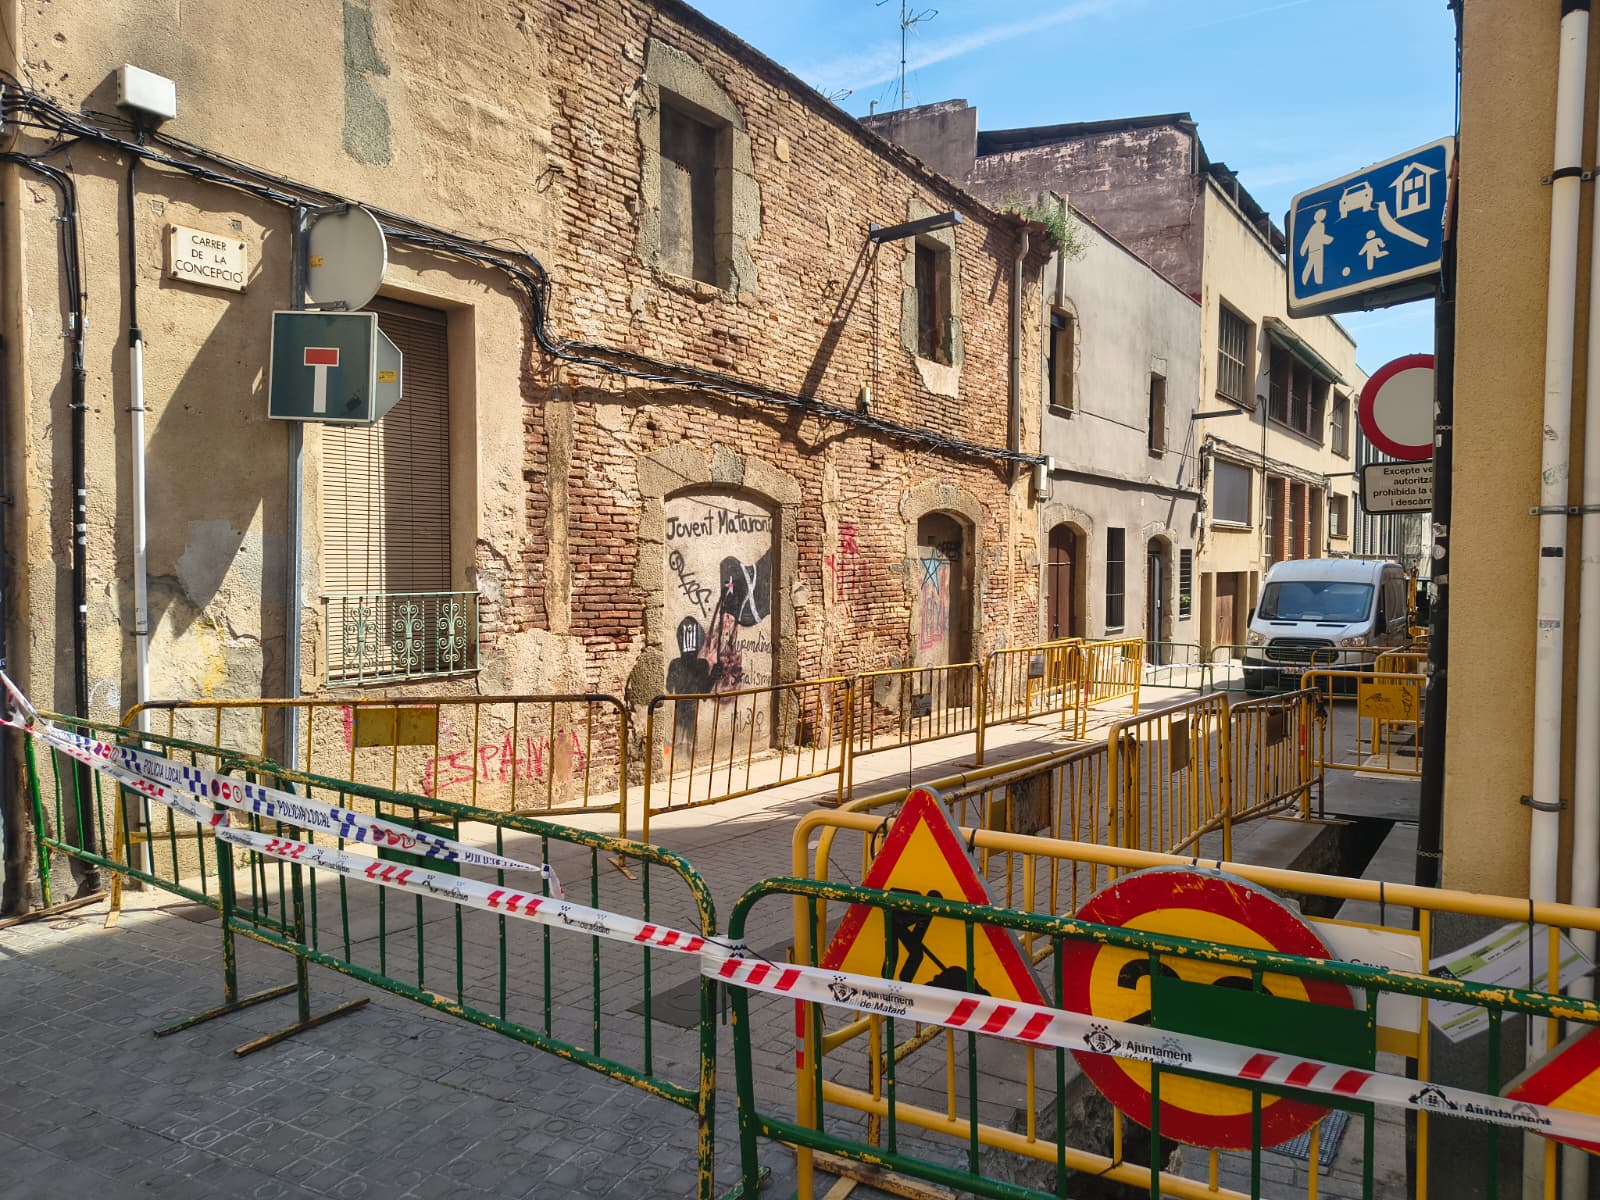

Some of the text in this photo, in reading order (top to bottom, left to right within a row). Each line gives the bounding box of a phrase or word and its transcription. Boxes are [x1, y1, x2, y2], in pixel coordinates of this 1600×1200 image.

[191, 235, 227, 251] CARRER
[191, 248, 227, 265] DE LA
[175, 259, 244, 284] CONCEPCIÓ
[1383, 466, 1420, 476] Excepte
[1373, 487, 1416, 499] prohibida
[1418, 487, 1427, 495] la
[666, 509, 714, 540] Jovent
[143, 758, 164, 779] POLICIA
[164, 765, 183, 785] LOCAL
[276, 799, 331, 829] POLICIA LOCAL
[859, 998, 907, 1017] de Mataró
[861, 988, 914, 1008] Ajuntament
[1126, 1040, 1193, 1063] Ajuntament
